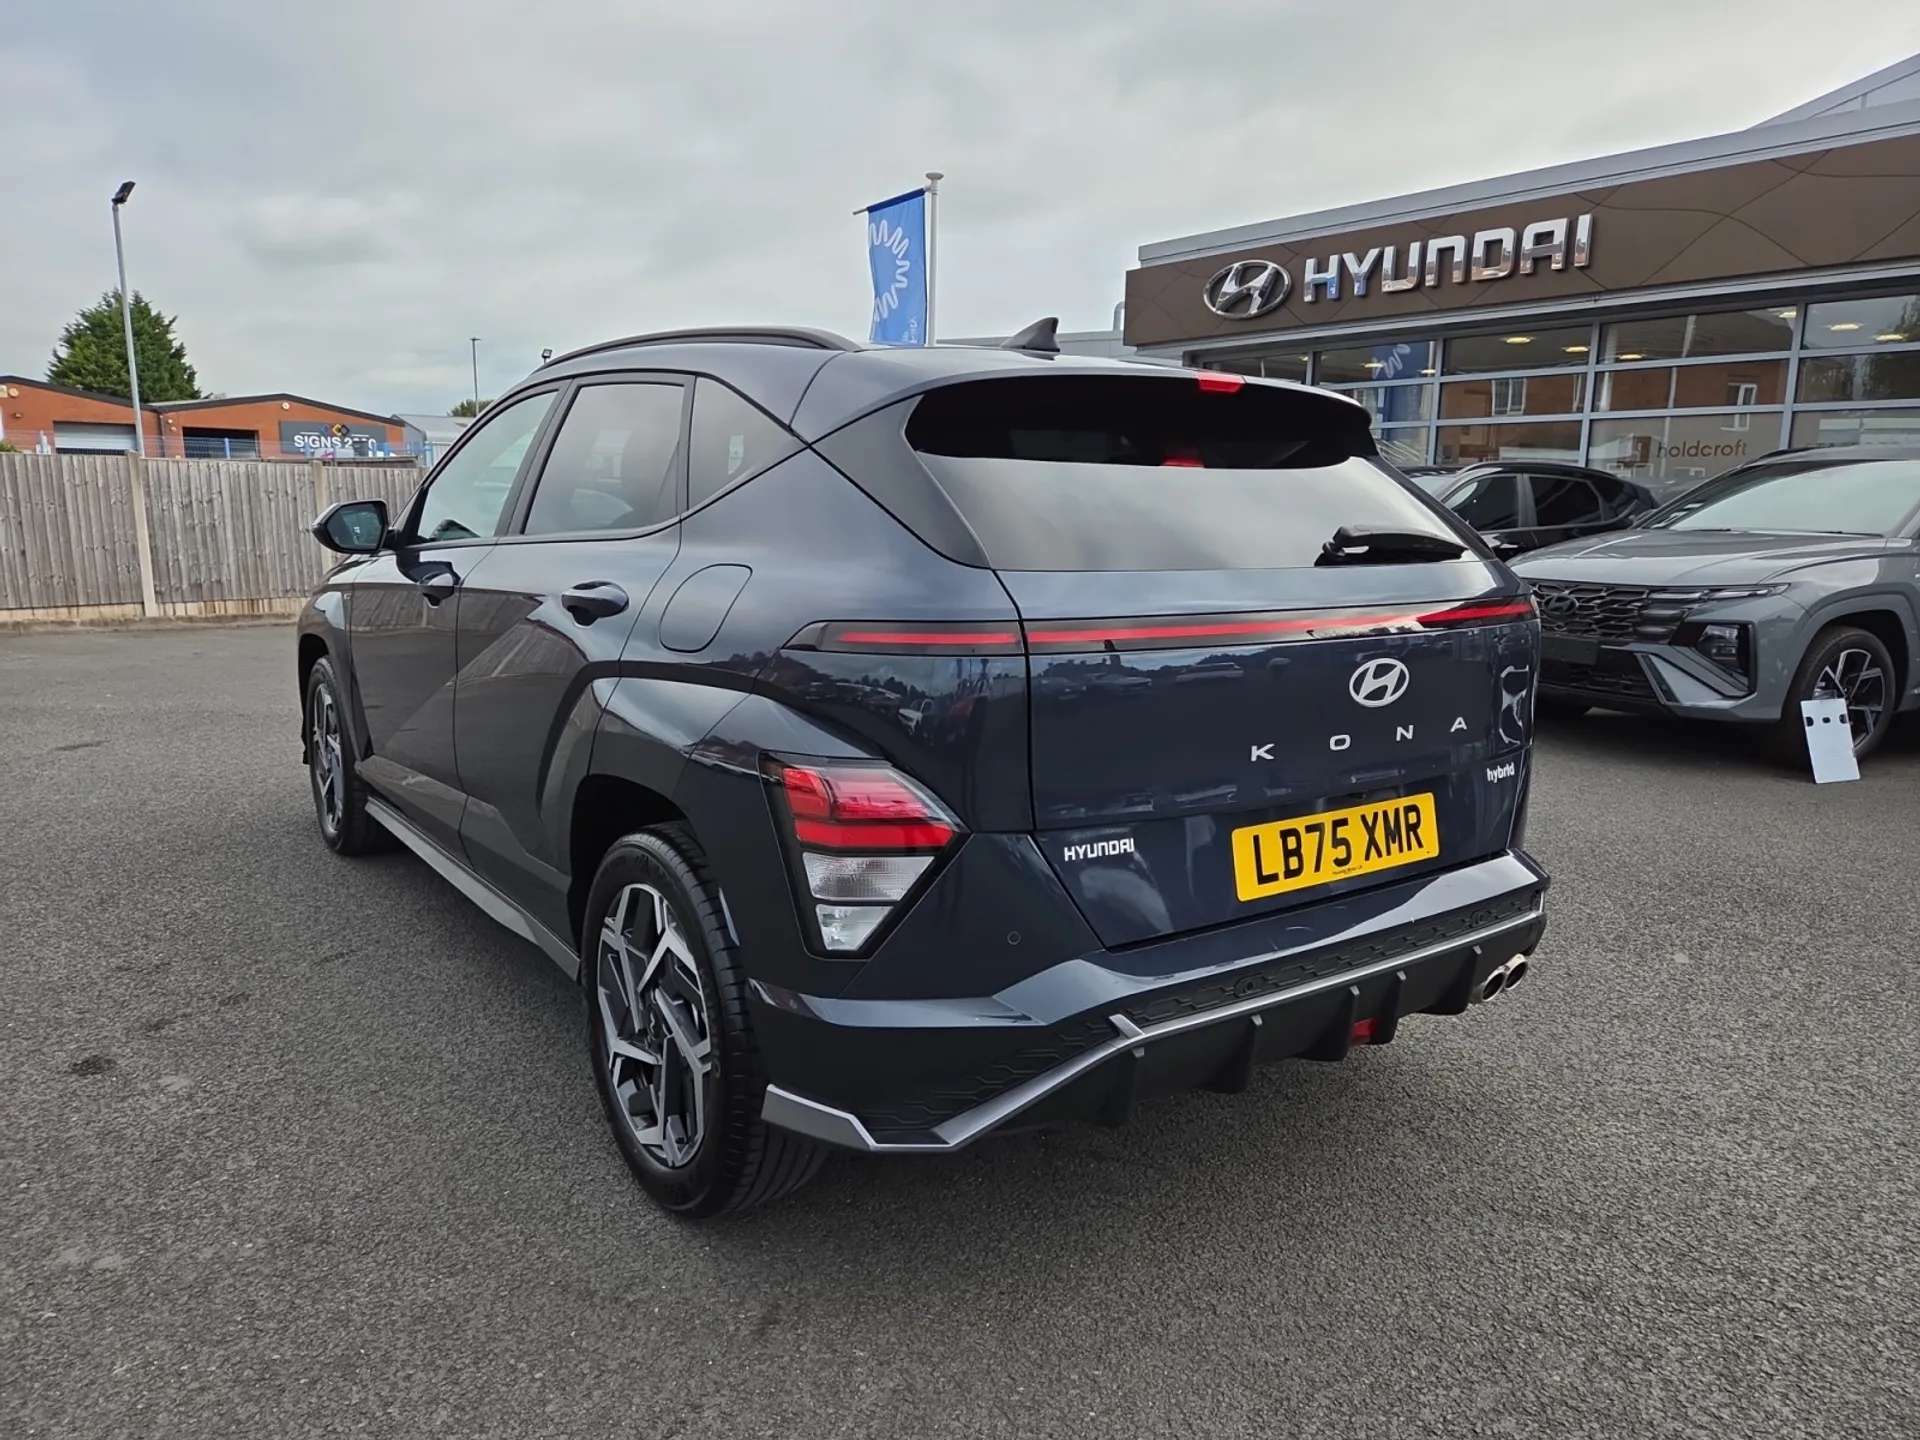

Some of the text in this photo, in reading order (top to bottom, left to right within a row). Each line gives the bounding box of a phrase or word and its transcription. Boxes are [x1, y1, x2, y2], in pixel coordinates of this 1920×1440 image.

[1303, 213, 1592, 303] HYUNDAI
[294, 435, 377, 450] SIGNS 20
[1656, 440, 1747, 458] holdcroft
[1250, 716, 1467, 762] KONA
[1486, 761, 1515, 783] hybrid
[1063, 837, 1135, 862] HYUNDAI
[1252, 803, 1424, 886] LB75 XMR
